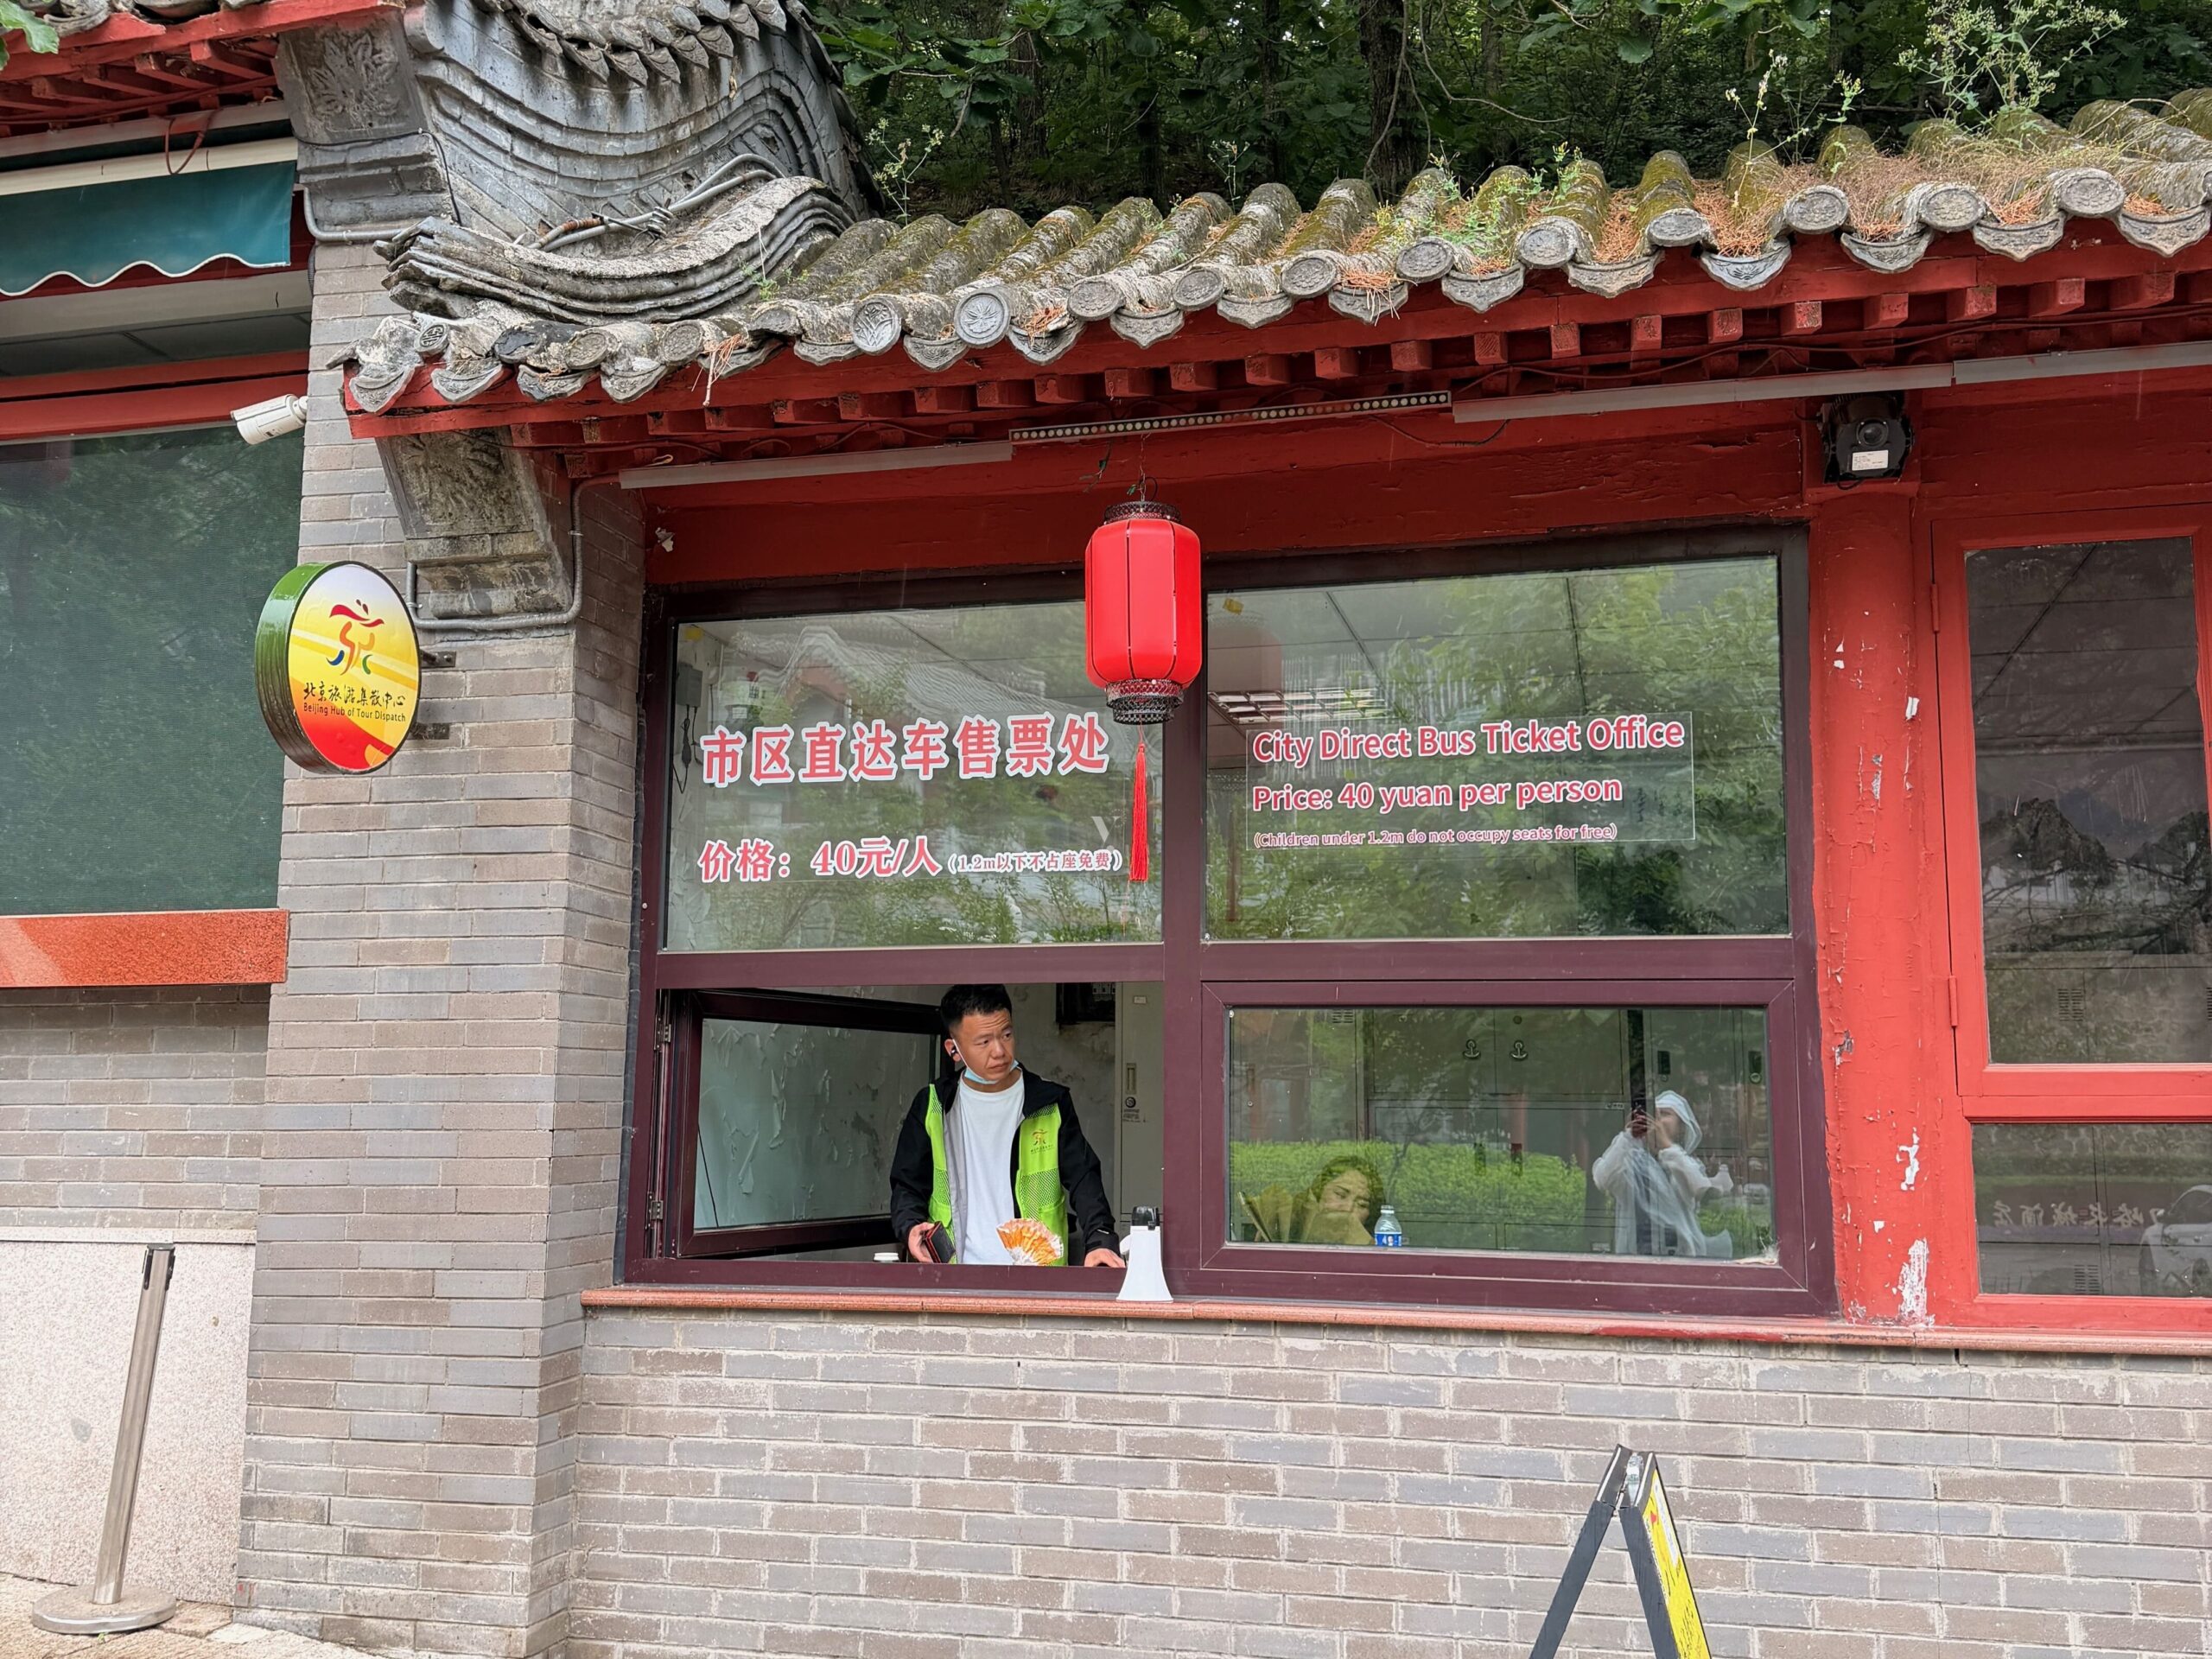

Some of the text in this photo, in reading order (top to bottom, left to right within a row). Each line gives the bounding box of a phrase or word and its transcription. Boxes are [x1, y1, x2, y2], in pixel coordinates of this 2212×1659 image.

[303, 681, 406, 709] 北京旅游集散中心
[303, 702, 406, 722] Beijing Hub of Tour Dispatch
[699, 712, 1109, 787] 市区直达车售票处
[1253, 715, 1685, 768] City Direct Bus Ticket Office
[1253, 779, 1623, 813] Price: 40 yuan per person
[1254, 823, 1618, 849] (Children under 1.2m do not occupy seats for free)
[810, 836, 943, 878] 40元/人
